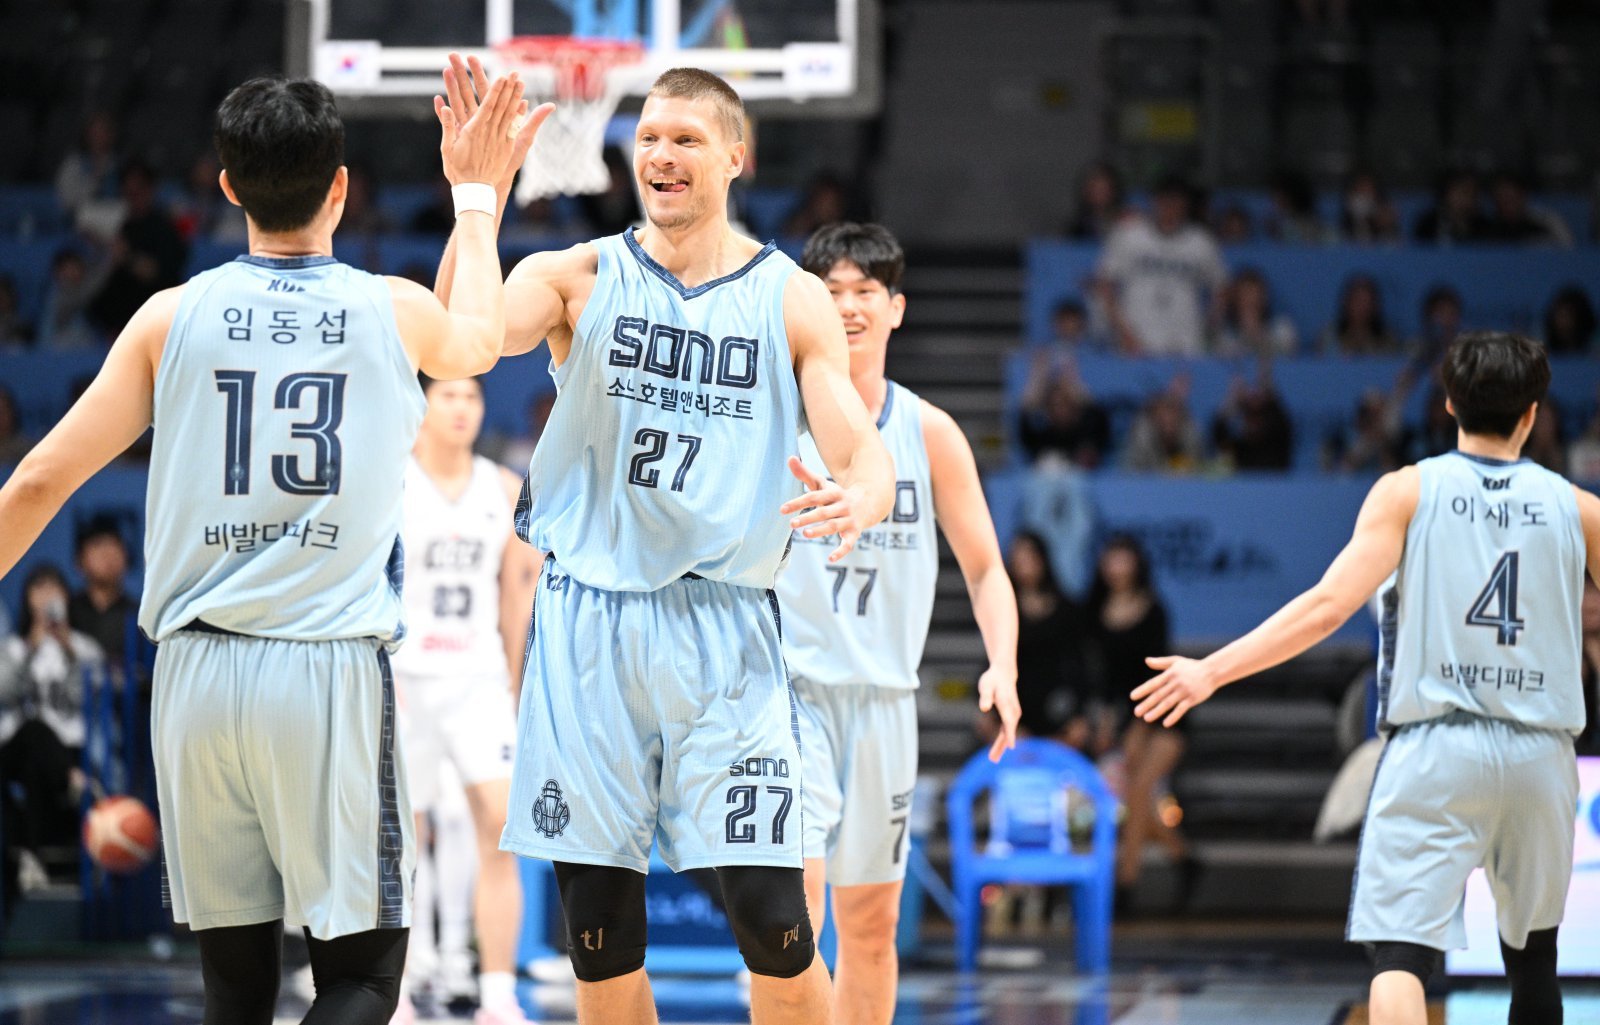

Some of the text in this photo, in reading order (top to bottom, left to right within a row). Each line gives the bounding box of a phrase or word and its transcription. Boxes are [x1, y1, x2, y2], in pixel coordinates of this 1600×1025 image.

[608, 315, 759, 390] SONO
[214, 370, 348, 496] 13
[628, 428, 703, 492] 27
[205, 519, 339, 554] 비발디파크
[825, 565, 877, 616] 77
[1465, 551, 1525, 646] 4
[1441, 663, 1545, 692] 비발디파크
[729, 757, 790, 778] SONO
[725, 785, 793, 845] 27
